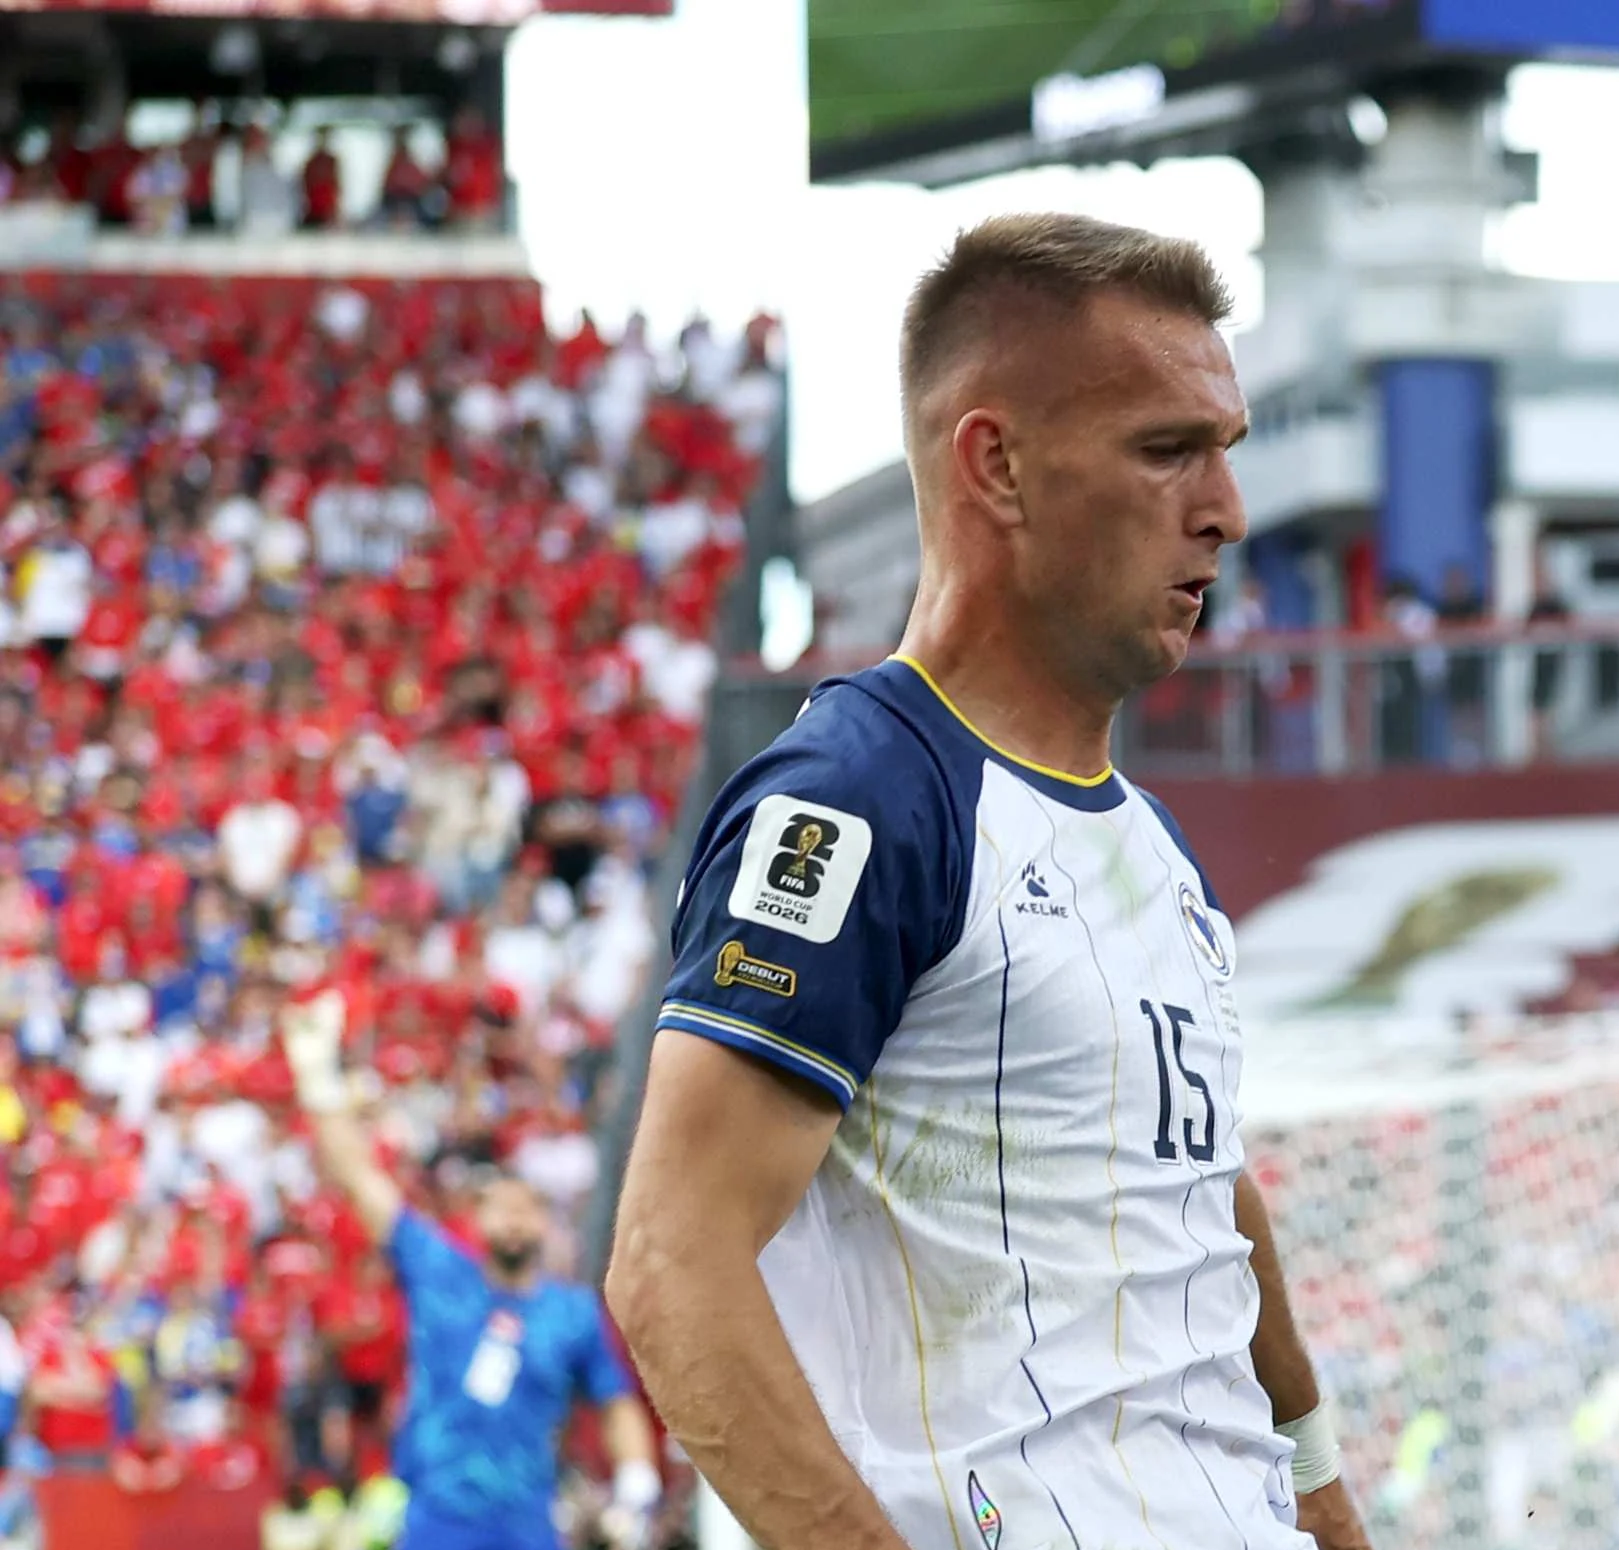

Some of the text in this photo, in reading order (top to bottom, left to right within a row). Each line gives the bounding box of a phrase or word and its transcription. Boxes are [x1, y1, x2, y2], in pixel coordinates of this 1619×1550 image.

[779, 875, 806, 891] FIFA
[760, 891, 813, 911] WORLD CUP
[1015, 902, 1069, 919] KELME
[755, 900, 808, 925] 2026
[738, 961, 789, 984] DEBUT
[1139, 998, 1217, 1165] 15
